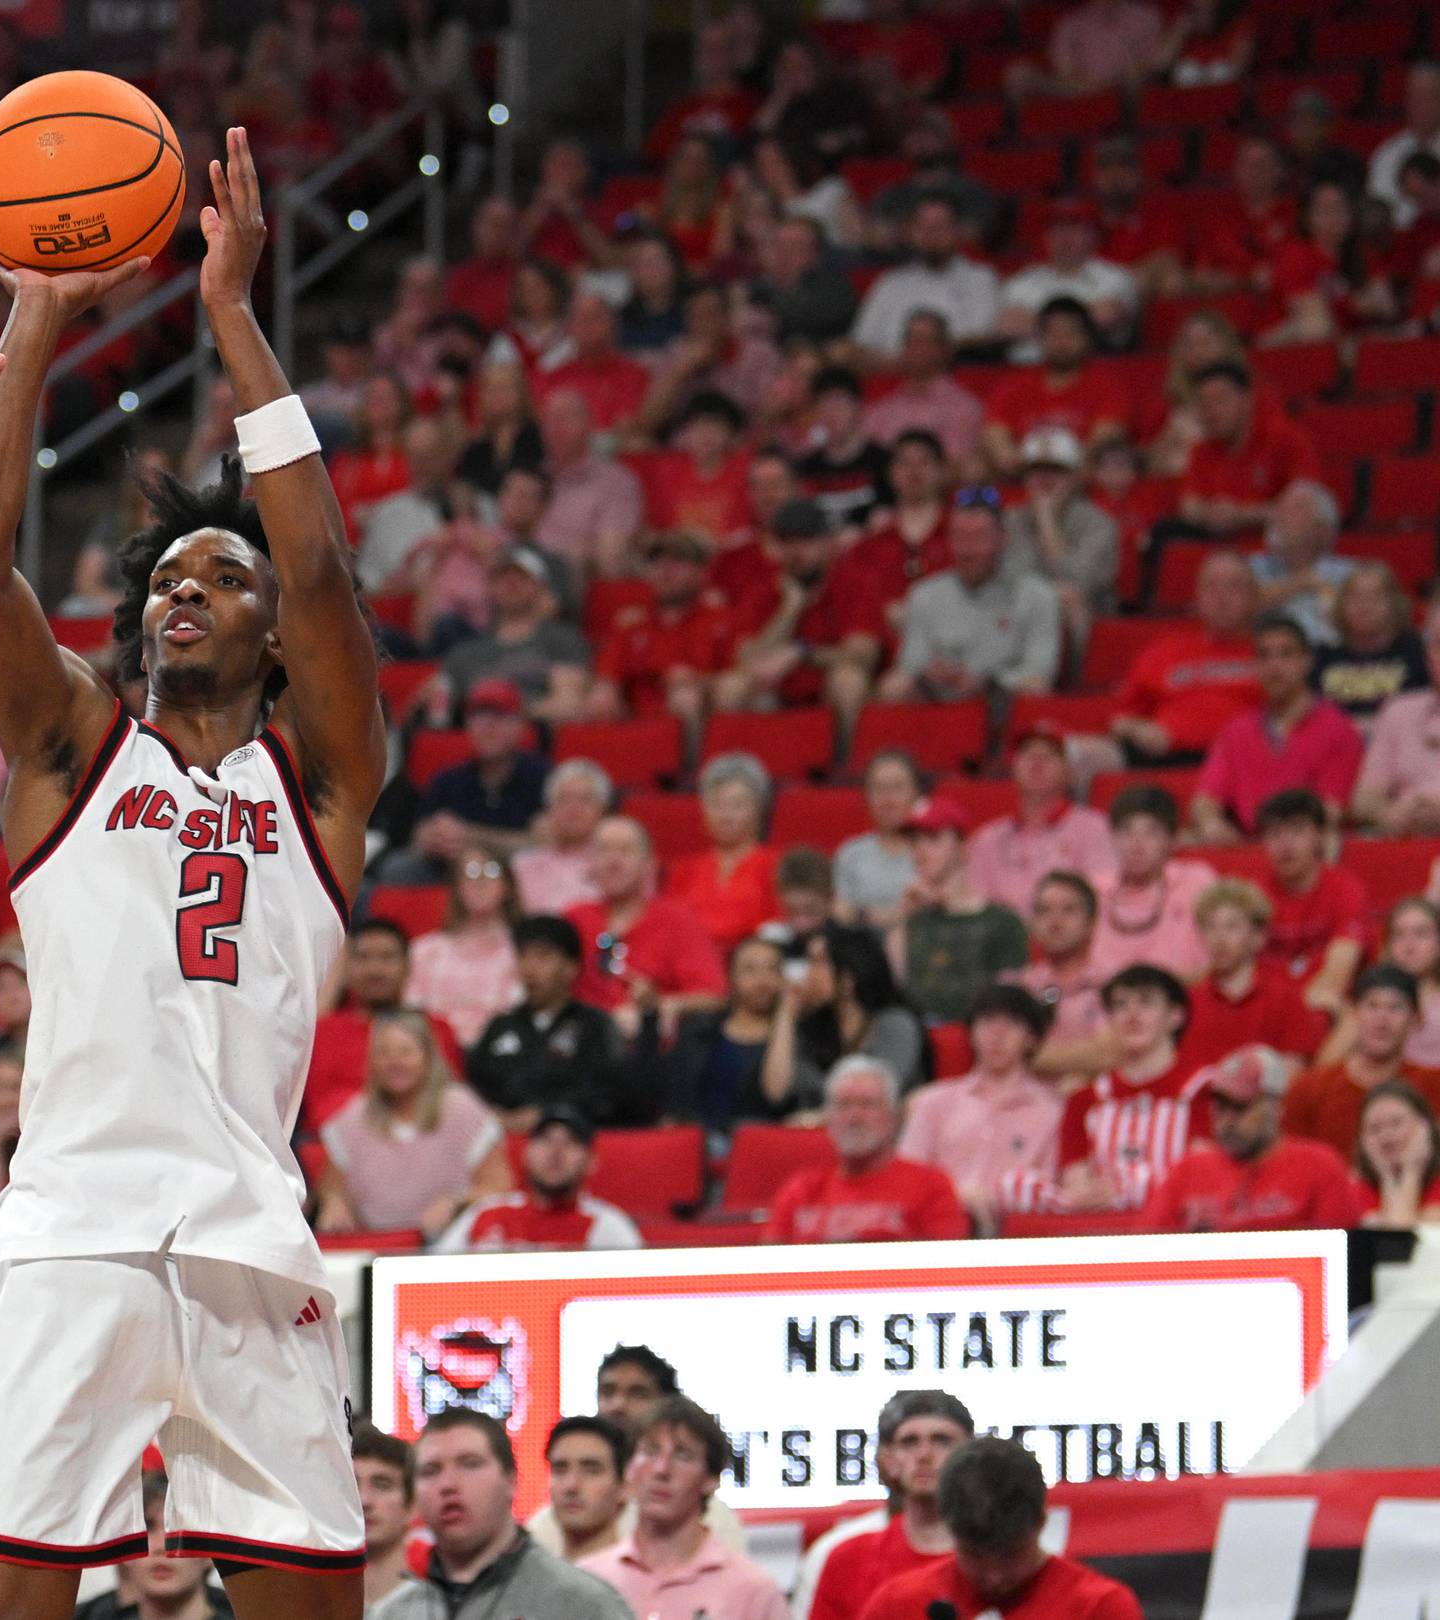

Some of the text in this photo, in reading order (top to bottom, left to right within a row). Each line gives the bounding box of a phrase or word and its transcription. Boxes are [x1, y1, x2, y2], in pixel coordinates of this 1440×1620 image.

[28, 223, 48, 232] BALL
[49, 220, 71, 231] GAME
[72, 212, 105, 227] OFFICIAL
[33, 225, 112, 255] PRO
[105, 784, 178, 832] NC
[176, 851, 248, 987] 2
[785, 1309, 1067, 1373] NC STATE
